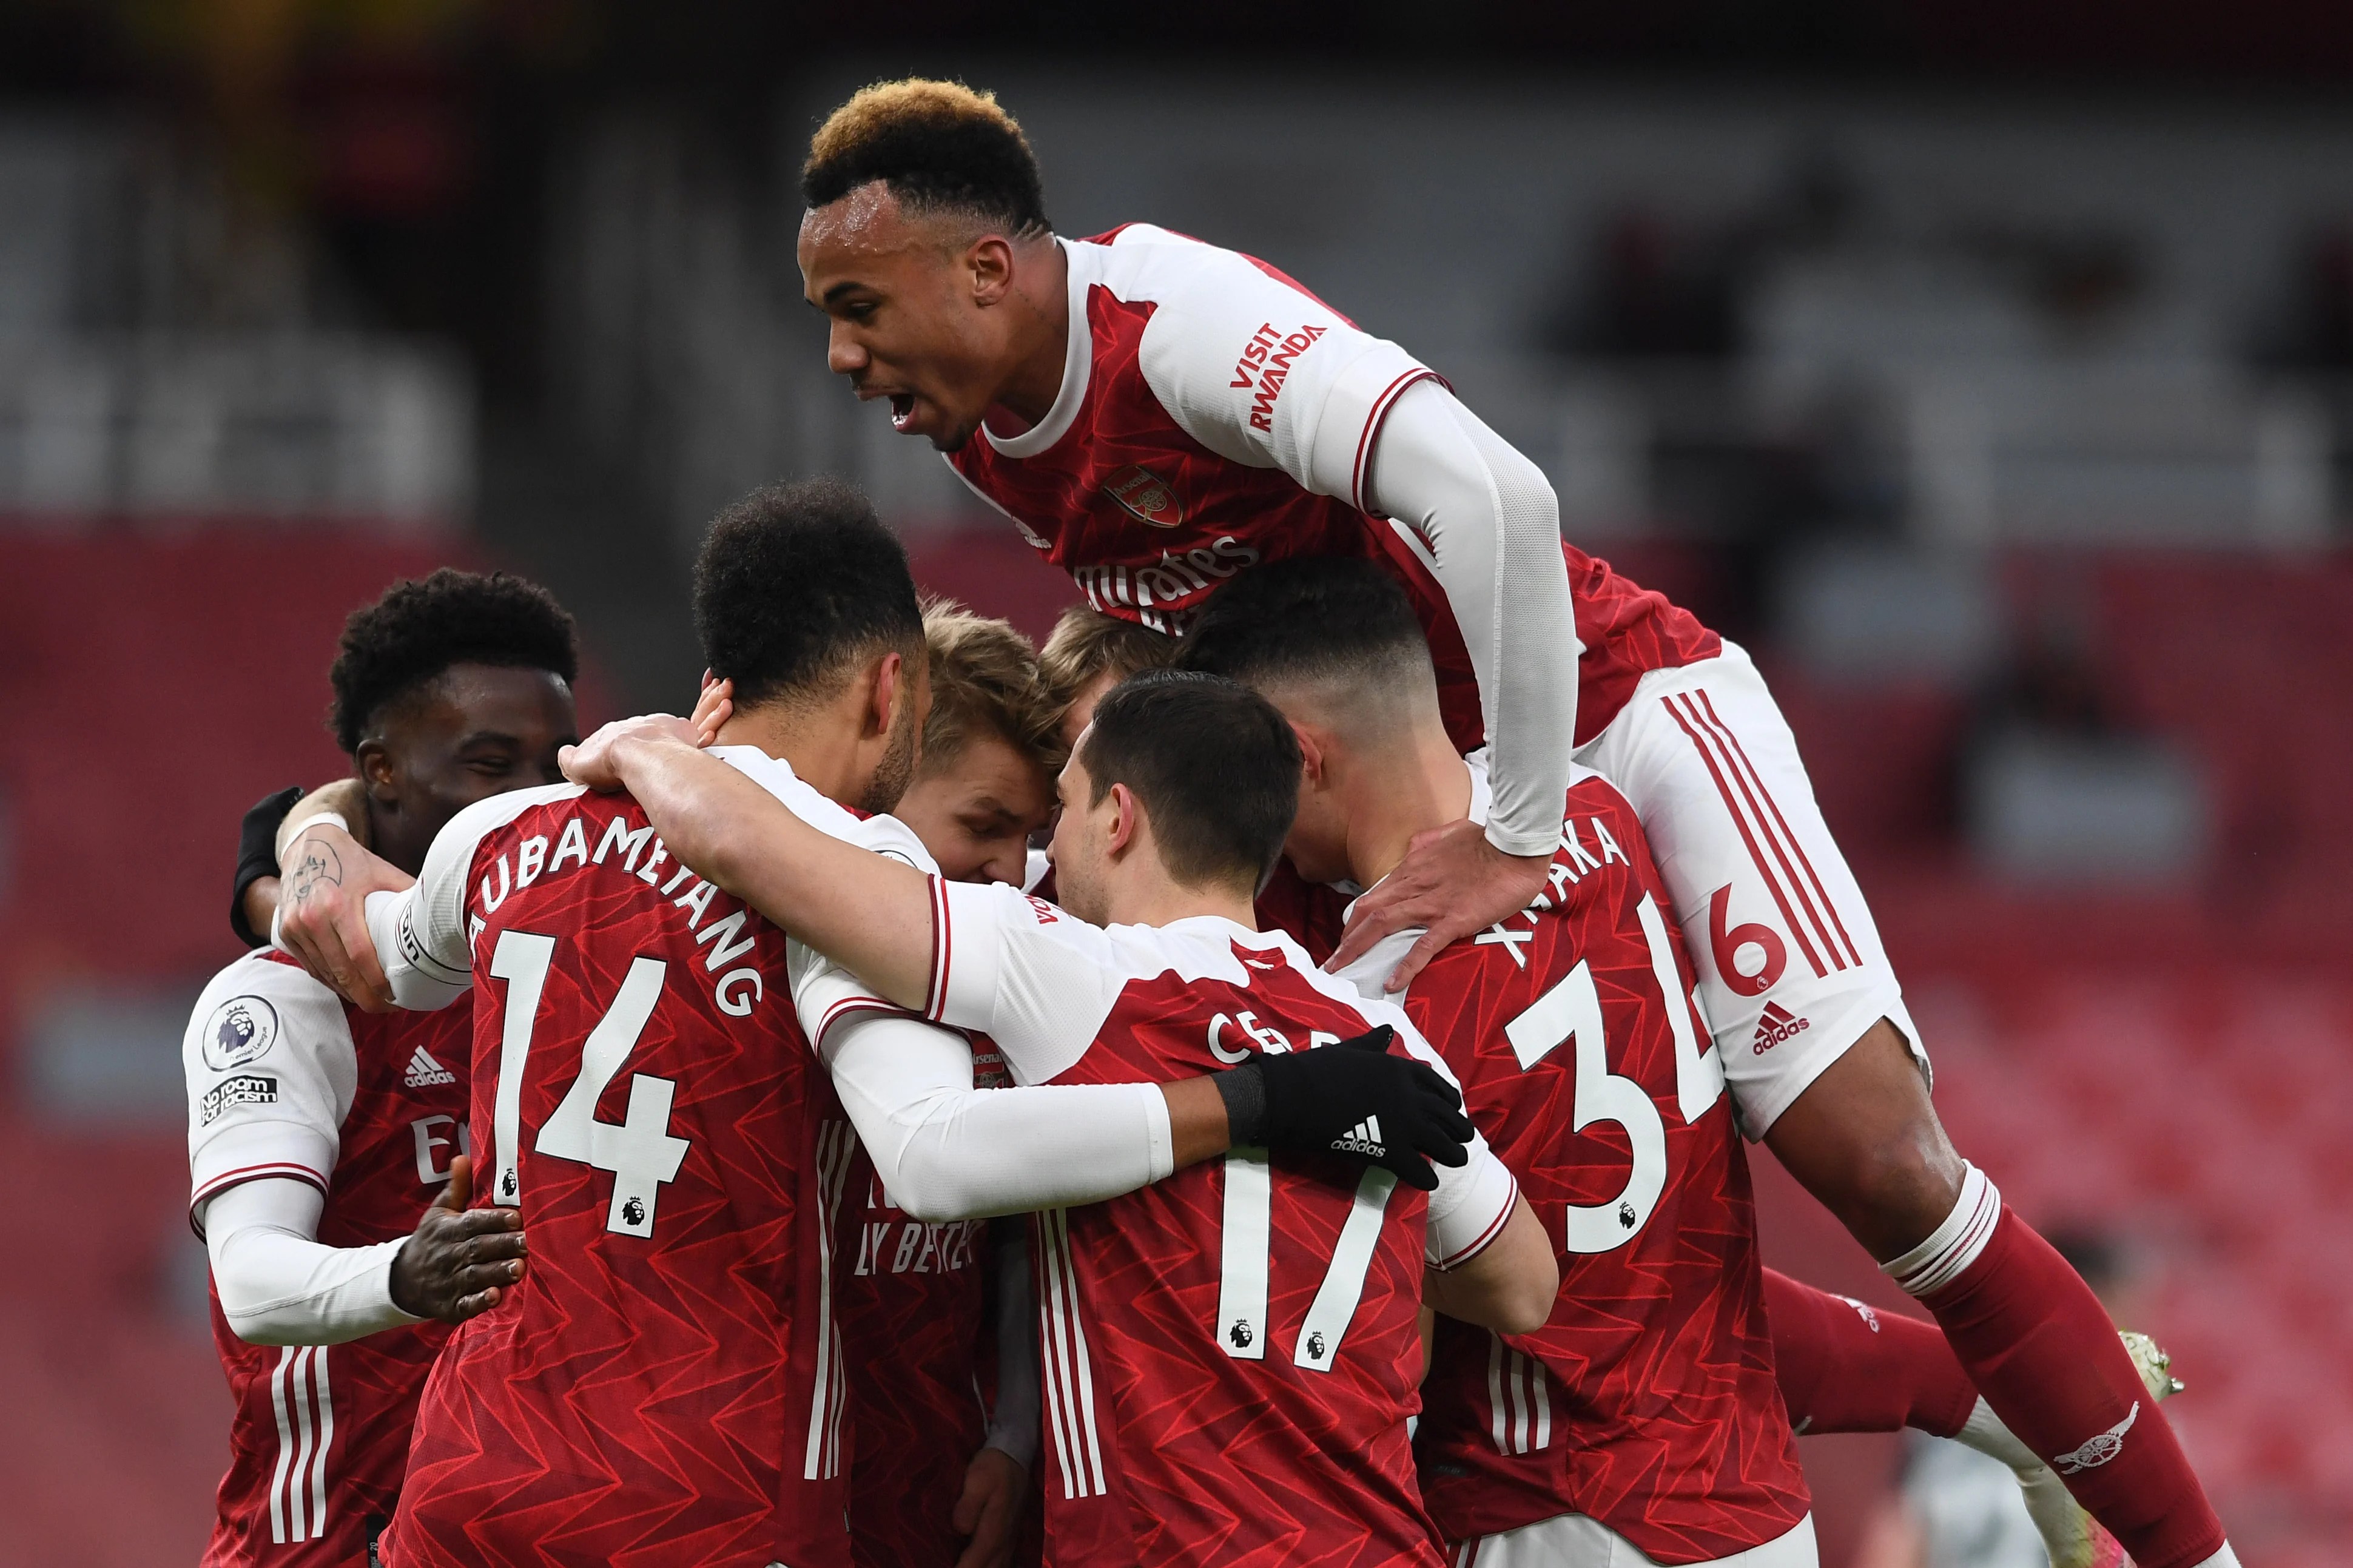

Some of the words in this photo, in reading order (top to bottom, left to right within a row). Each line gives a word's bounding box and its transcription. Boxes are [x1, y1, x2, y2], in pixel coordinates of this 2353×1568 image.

[1230, 322, 1282, 388] VISIT
[1250, 325, 1328, 434] RWANDA
[1113, 469, 1153, 497] Arsenal
[1074, 536, 1259, 612] mirates
[1708, 881, 1786, 997] 6
[1752, 1017, 1810, 1056] adidas
[201, 1091, 220, 1109] No
[220, 1078, 268, 1099] room
[404, 1071, 456, 1088] adidas
[489, 929, 691, 1239] 14
[1504, 889, 1726, 1253] 34
[201, 1103, 220, 1126] for
[220, 1091, 277, 1112] racism
[1330, 1137, 1387, 1158] adidas
